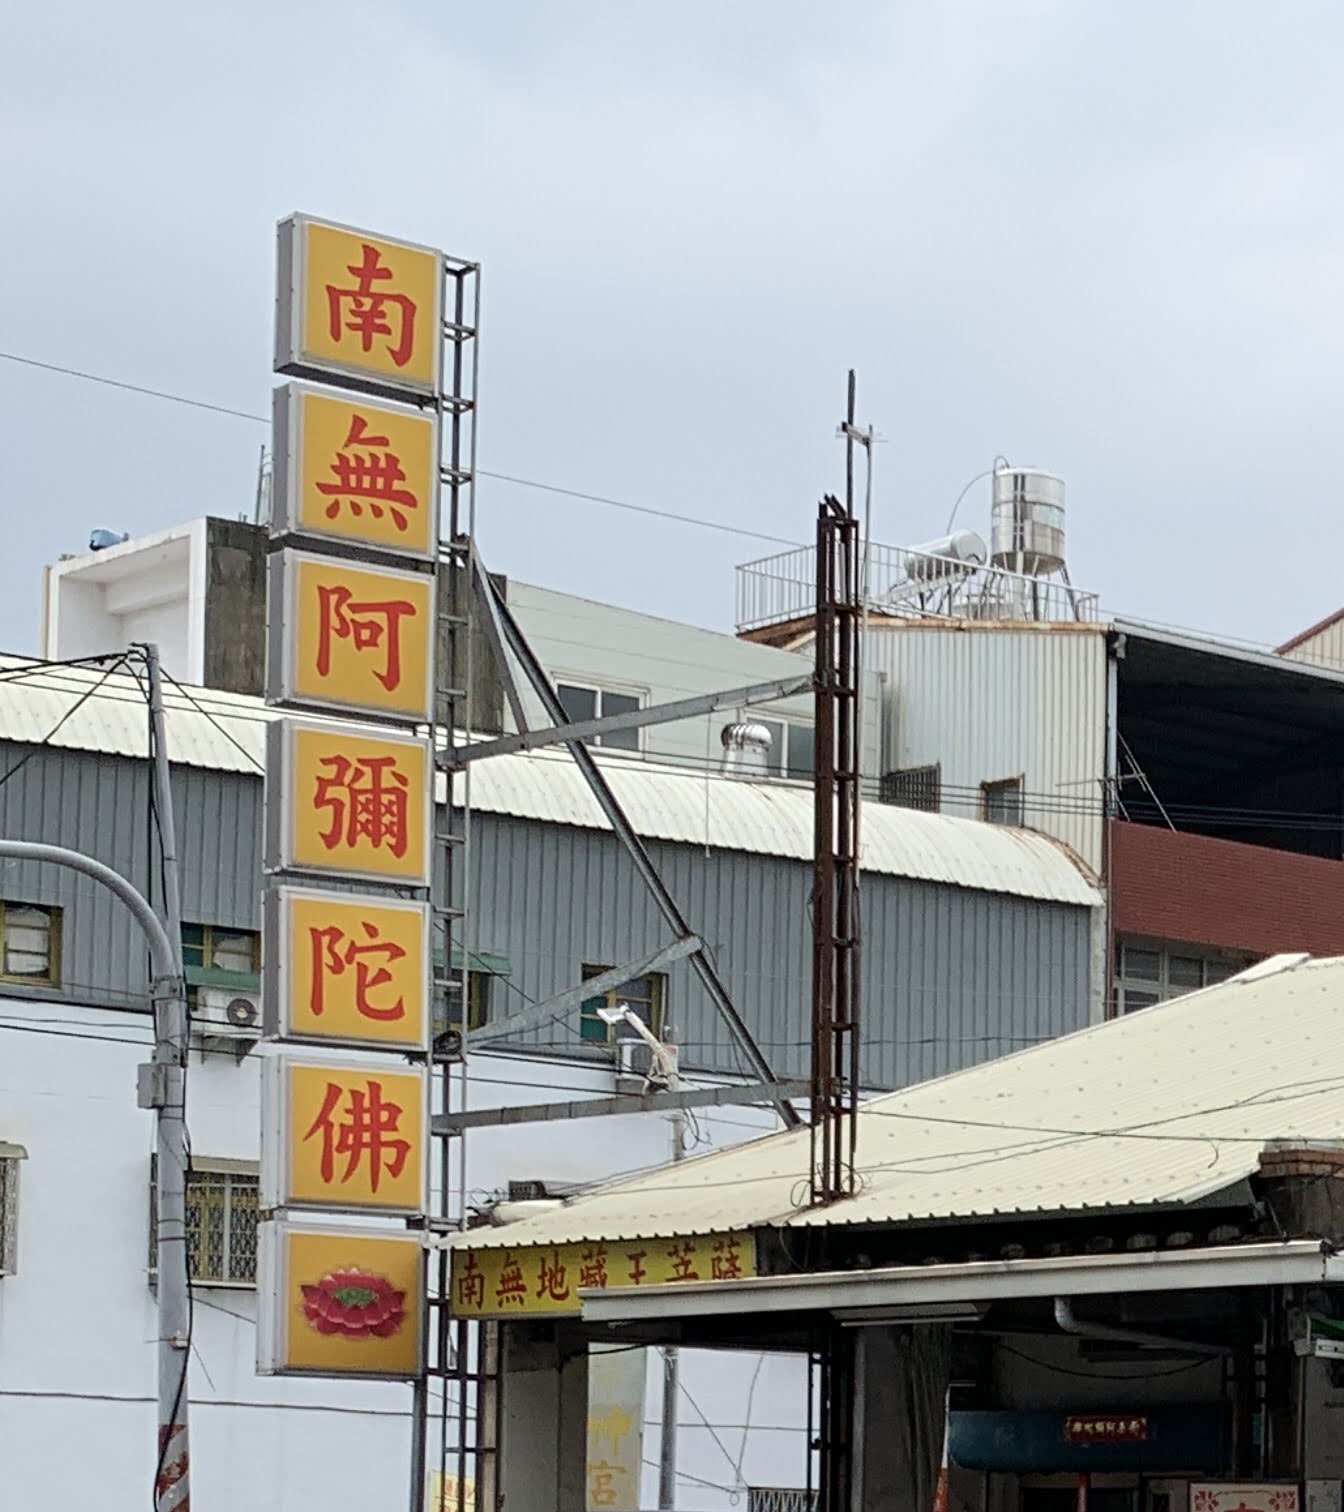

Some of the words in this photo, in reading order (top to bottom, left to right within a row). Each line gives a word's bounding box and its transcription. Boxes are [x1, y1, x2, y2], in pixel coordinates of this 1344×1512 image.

[303, 244, 418, 1194] 南無阿彌陀佛
